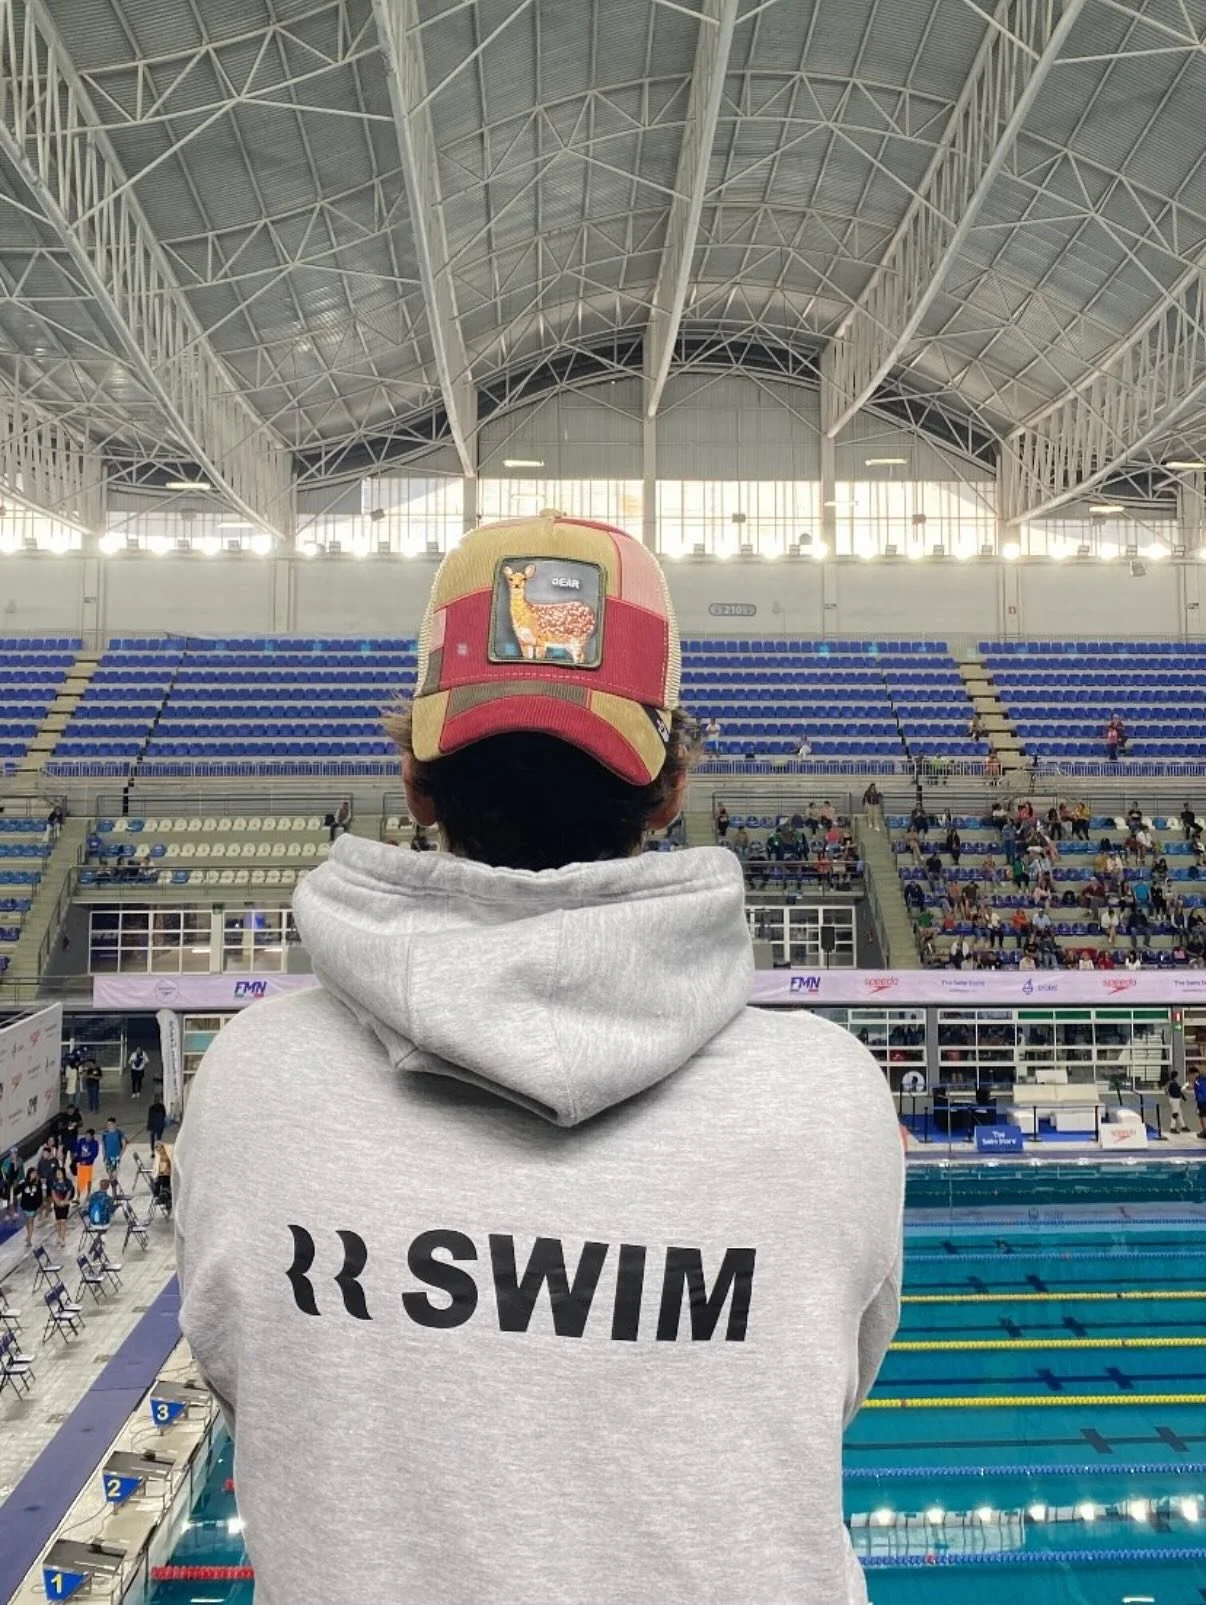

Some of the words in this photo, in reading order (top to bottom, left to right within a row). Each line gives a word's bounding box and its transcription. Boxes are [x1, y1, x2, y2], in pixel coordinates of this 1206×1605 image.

[235, 981, 267, 994] FMN
[791, 976, 821, 989] FMN
[864, 976, 898, 988] speedo
[402, 1228, 757, 1342] SWIM
[157, 1404, 169, 1421] 3
[107, 1479, 121, 1497] 2
[50, 1573, 62, 1594] 1
